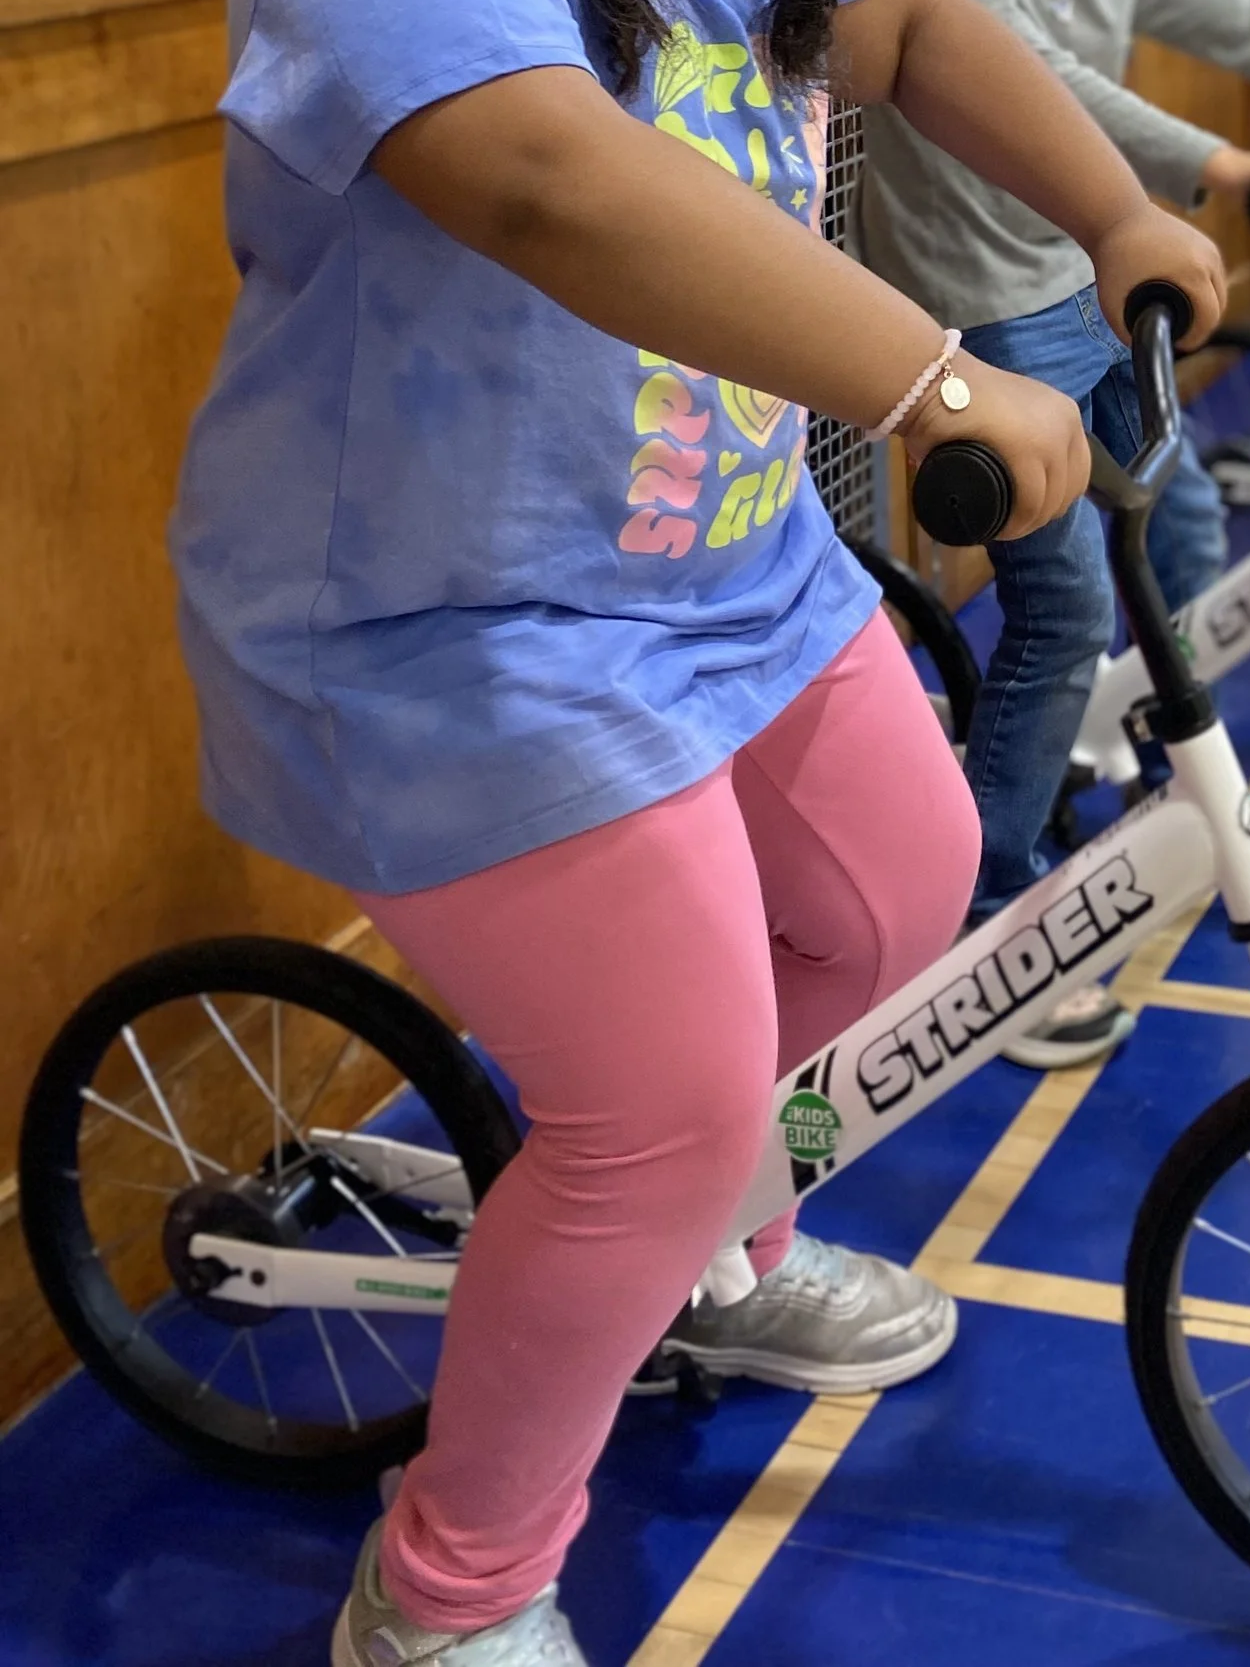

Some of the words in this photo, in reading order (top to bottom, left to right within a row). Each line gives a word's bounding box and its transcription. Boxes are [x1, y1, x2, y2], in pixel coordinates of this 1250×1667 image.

[857, 855, 1153, 1115] STRIDER
[793, 1106, 836, 1126] KIDS
[785, 1126, 836, 1146] BIKE
